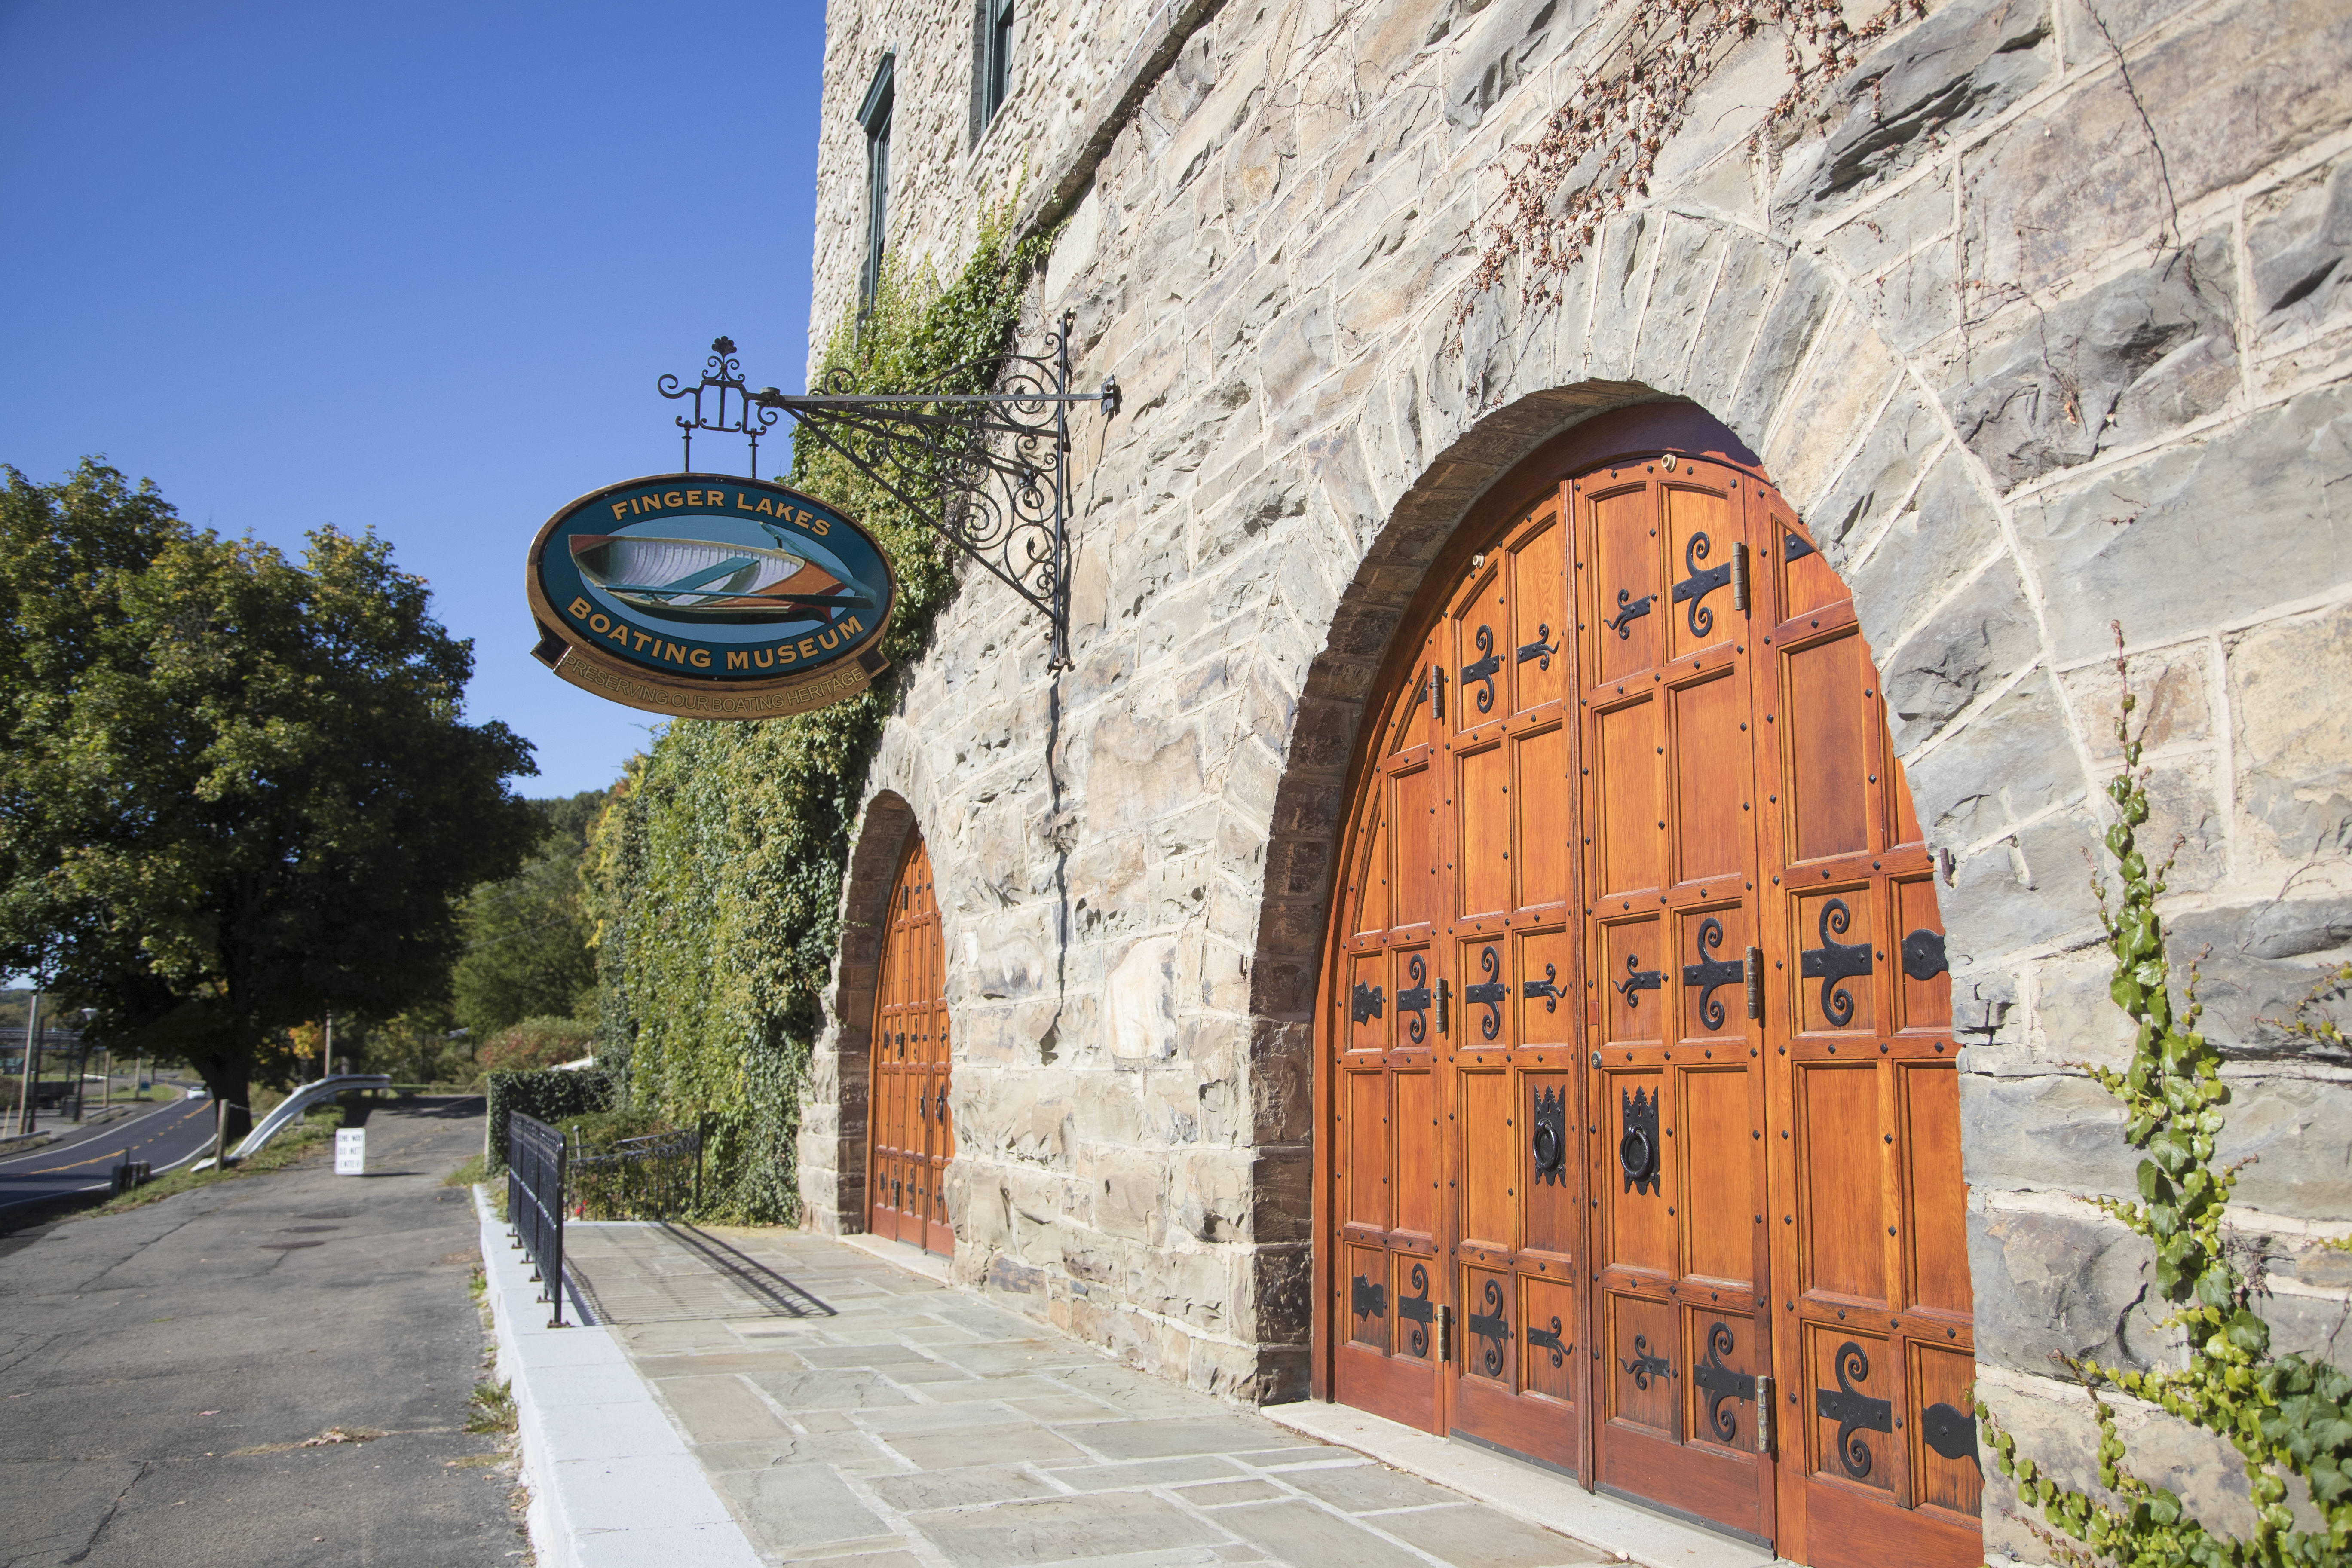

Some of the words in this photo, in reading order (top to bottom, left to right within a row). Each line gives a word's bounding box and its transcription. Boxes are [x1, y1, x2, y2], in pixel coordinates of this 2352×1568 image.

[611, 489, 725, 521] FINGER
[736, 493, 831, 536] LAKES
[566, 596, 712, 669] BOATING
[726, 615, 865, 671] MUSEUM
[562, 654, 669, 705] PRESERVING
[671, 692, 710, 711] OUR
[711, 694, 785, 712] BOATING
[787, 667, 865, 706] HERITAGE
[339, 1134, 349, 1142] ONE
[351, 1146, 362, 1155] NOT
[339, 1160, 361, 1168] ENTER
